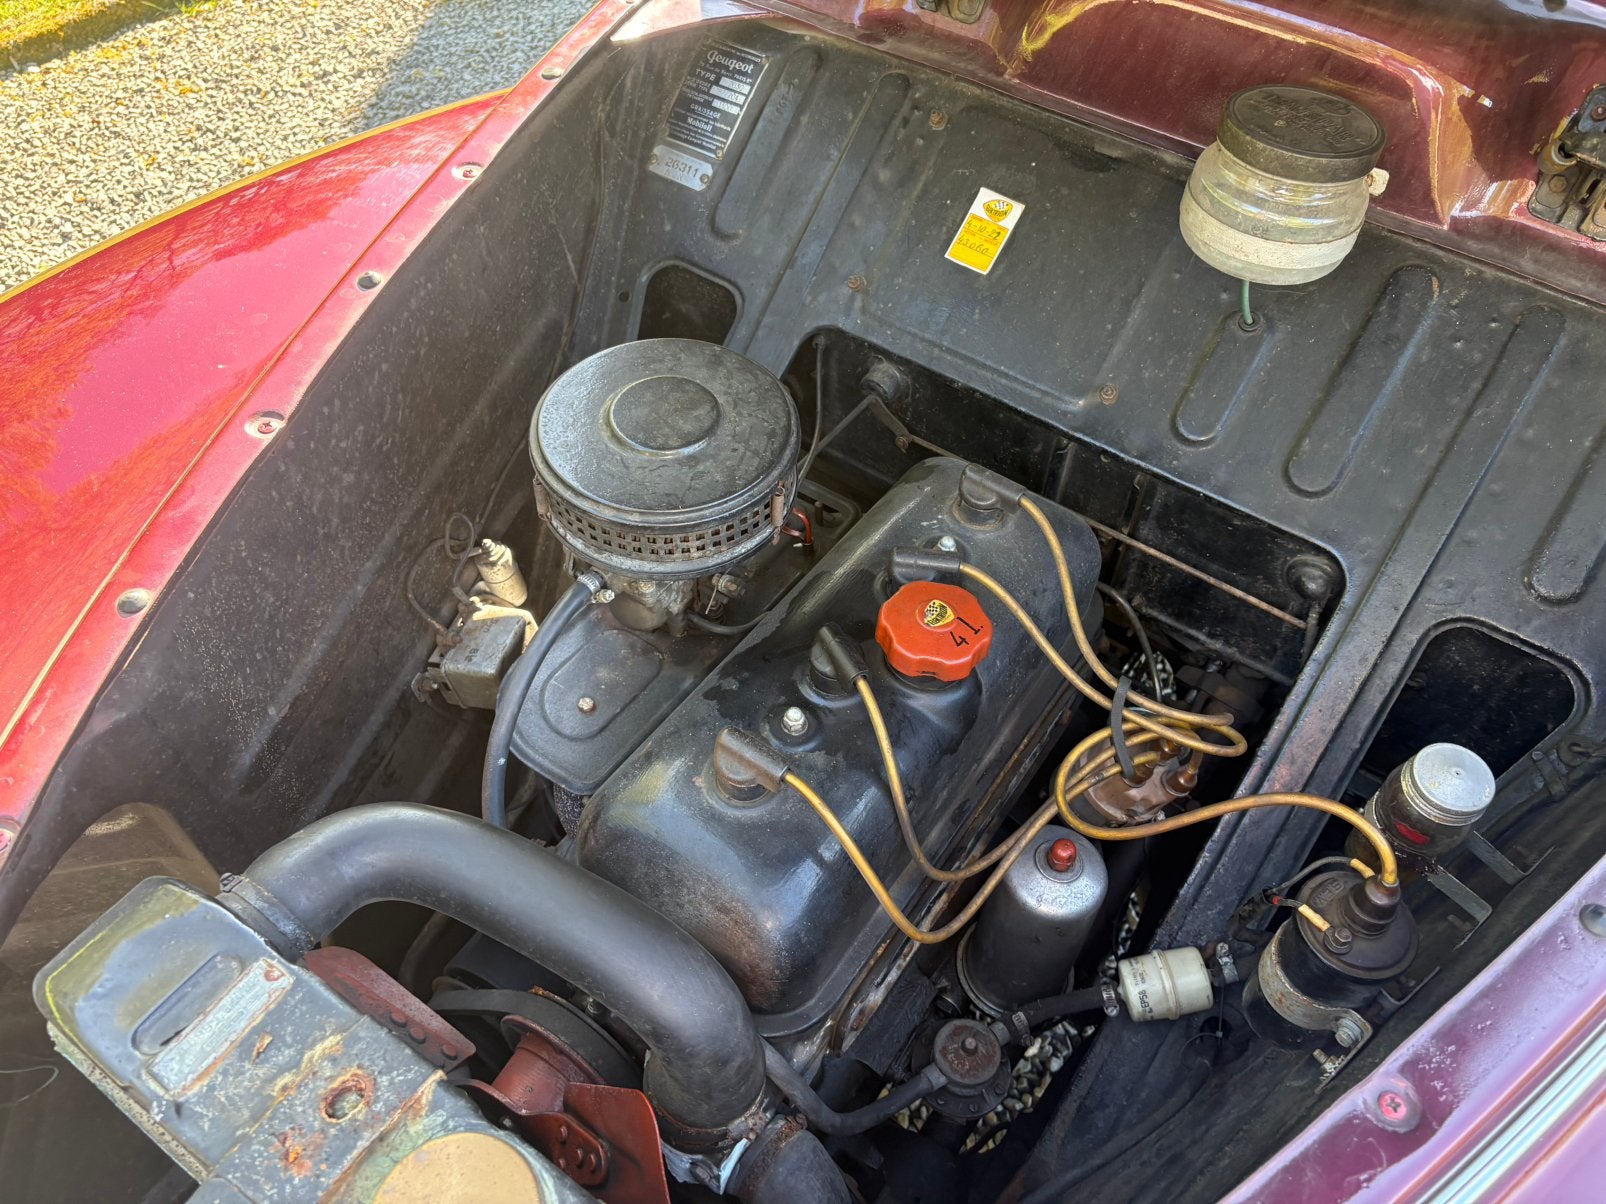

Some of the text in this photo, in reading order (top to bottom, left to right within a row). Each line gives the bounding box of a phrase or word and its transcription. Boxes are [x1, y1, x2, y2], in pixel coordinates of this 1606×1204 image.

[707, 50, 754, 74] Peugeot
[695, 68, 716, 81] TYPE
[665, 156, 699, 177] 26311
[950, 631, 970, 647] 4
[1138, 989, 1151, 1009] EP58
